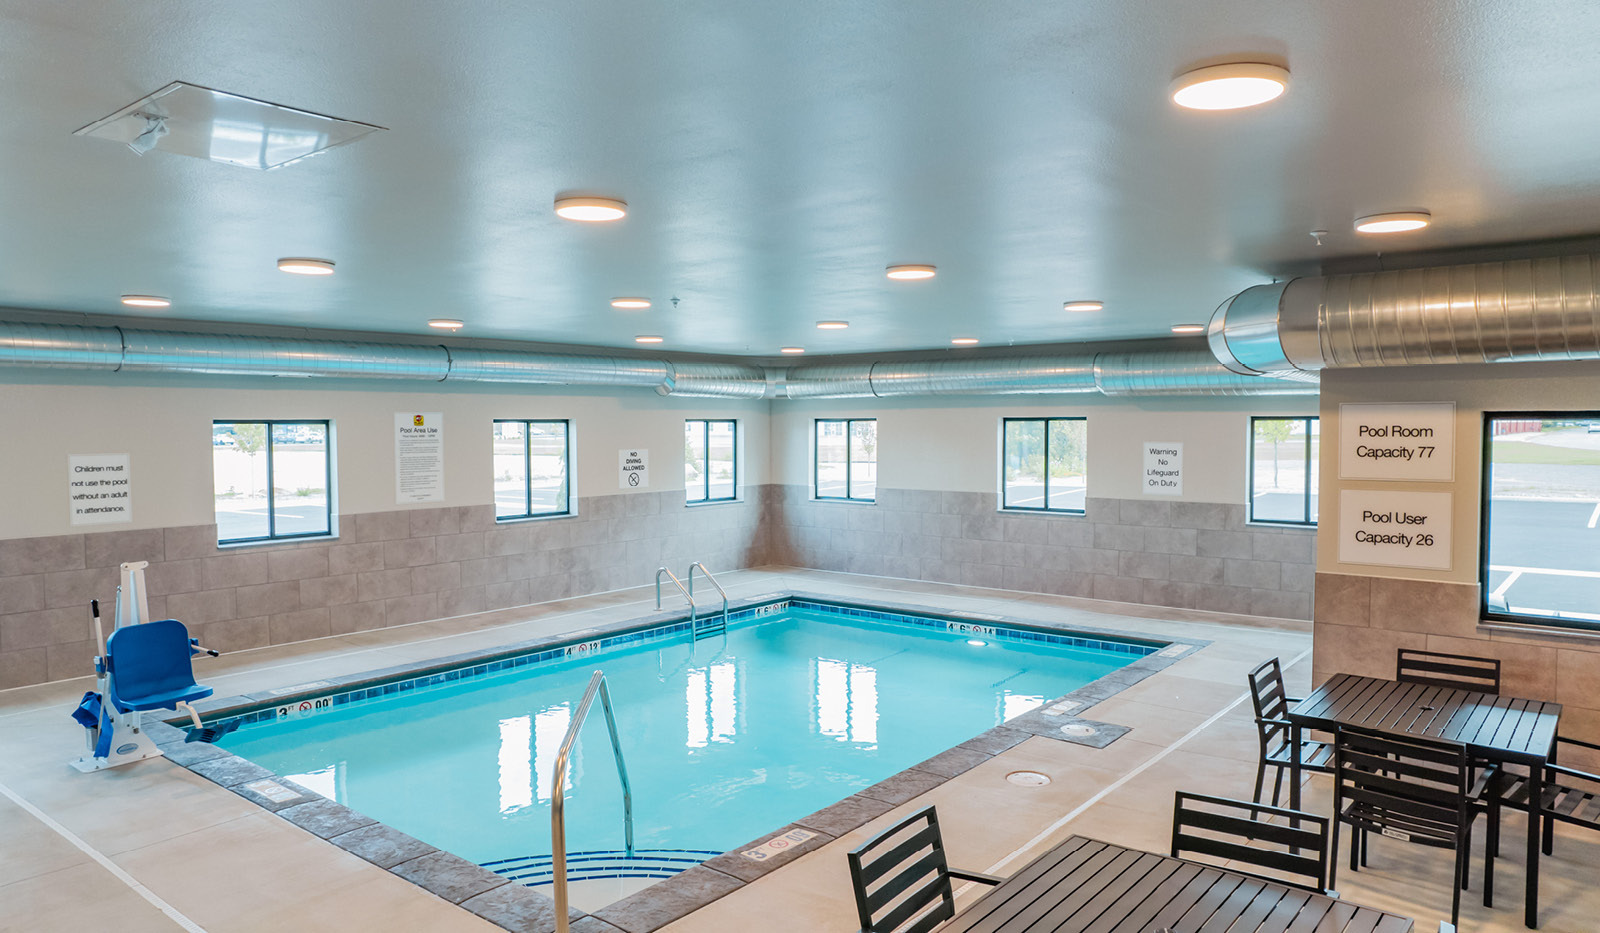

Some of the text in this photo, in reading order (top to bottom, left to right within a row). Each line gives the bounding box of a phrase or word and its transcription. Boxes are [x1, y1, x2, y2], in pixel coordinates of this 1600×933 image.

[1359, 425, 1433, 438] Pool Room
[1149, 448, 1178, 457] Warning
[1356, 445, 1435, 461] Capacity 77
[74, 465, 104, 473] Children
[1147, 469, 1179, 477] Lifeguard
[1160, 479, 1178, 487] Duty
[111, 491, 128, 499] adult
[1363, 510, 1427, 525] Pool User
[1355, 530, 1434, 548] Capacity 26
